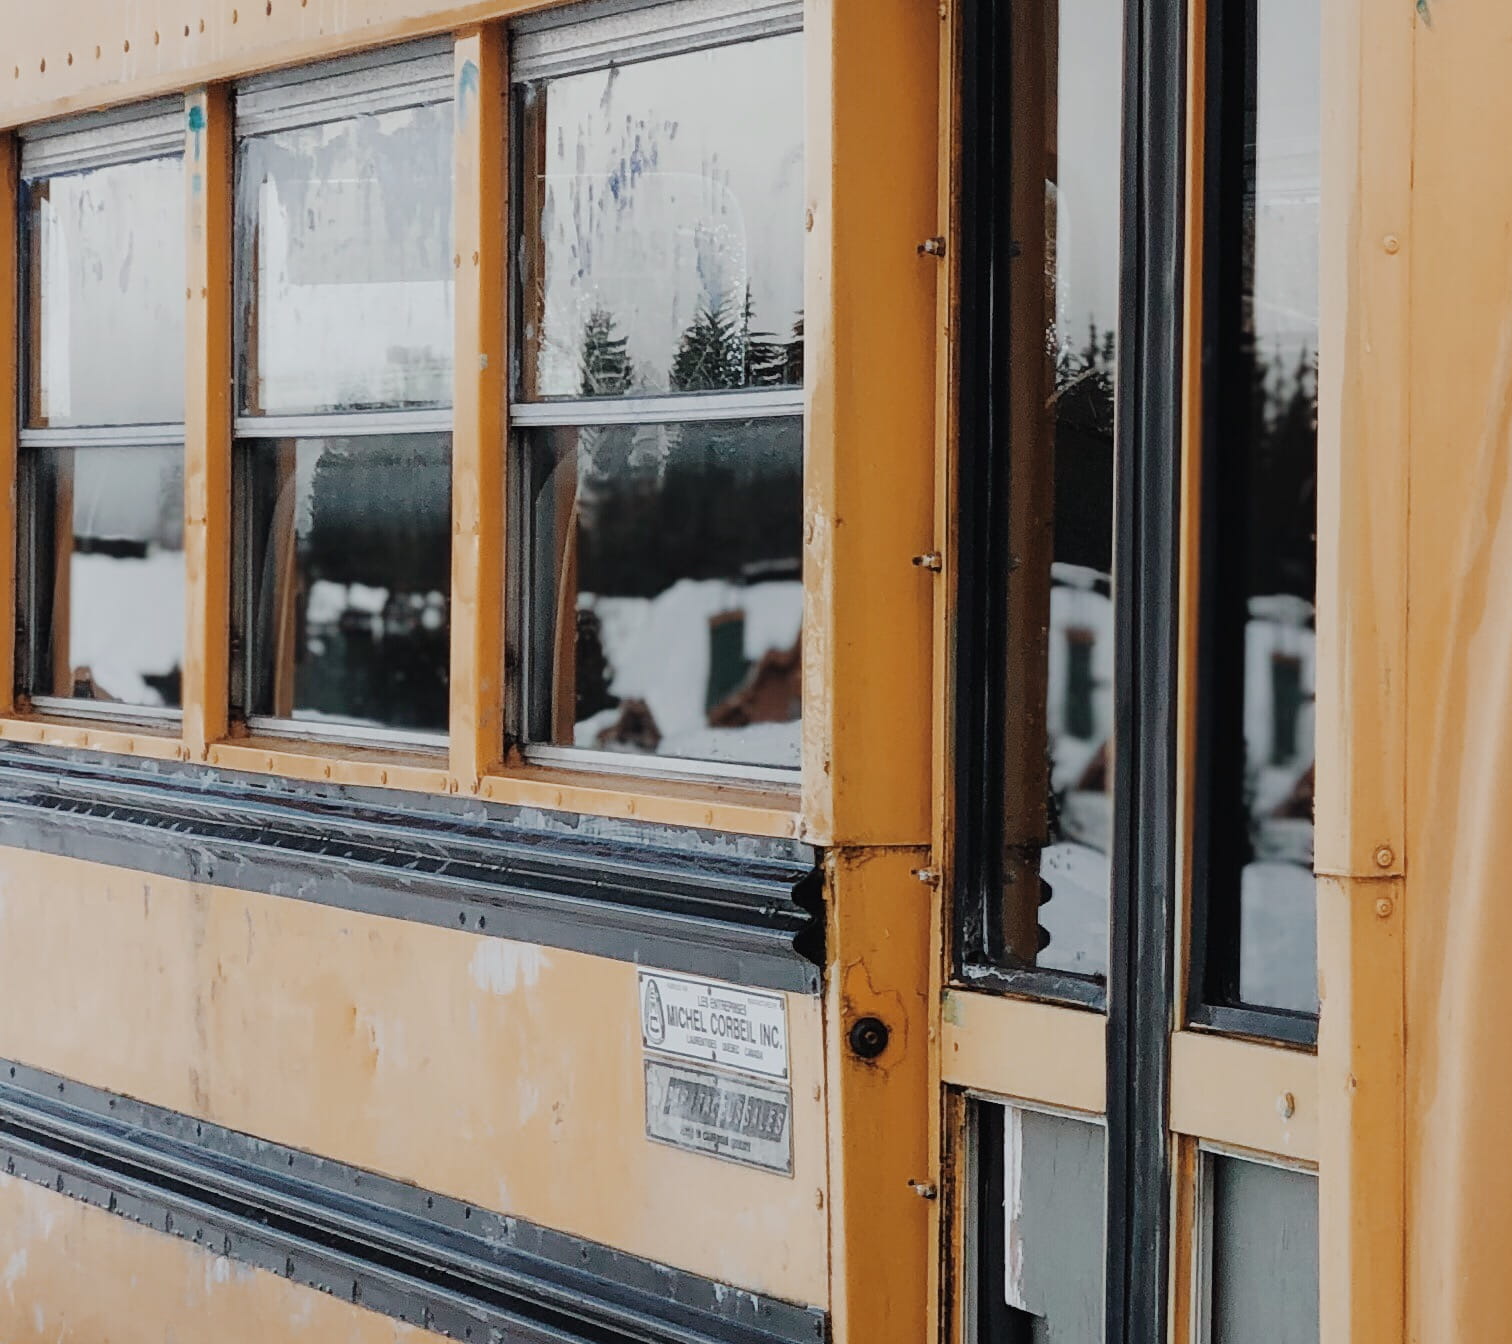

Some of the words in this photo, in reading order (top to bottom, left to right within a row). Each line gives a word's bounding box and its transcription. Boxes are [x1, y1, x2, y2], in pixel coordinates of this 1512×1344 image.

[666, 1004, 707, 1033] MICHEL
[710, 1012, 756, 1044] CORBEIL
[760, 1023, 783, 1050] INC.
